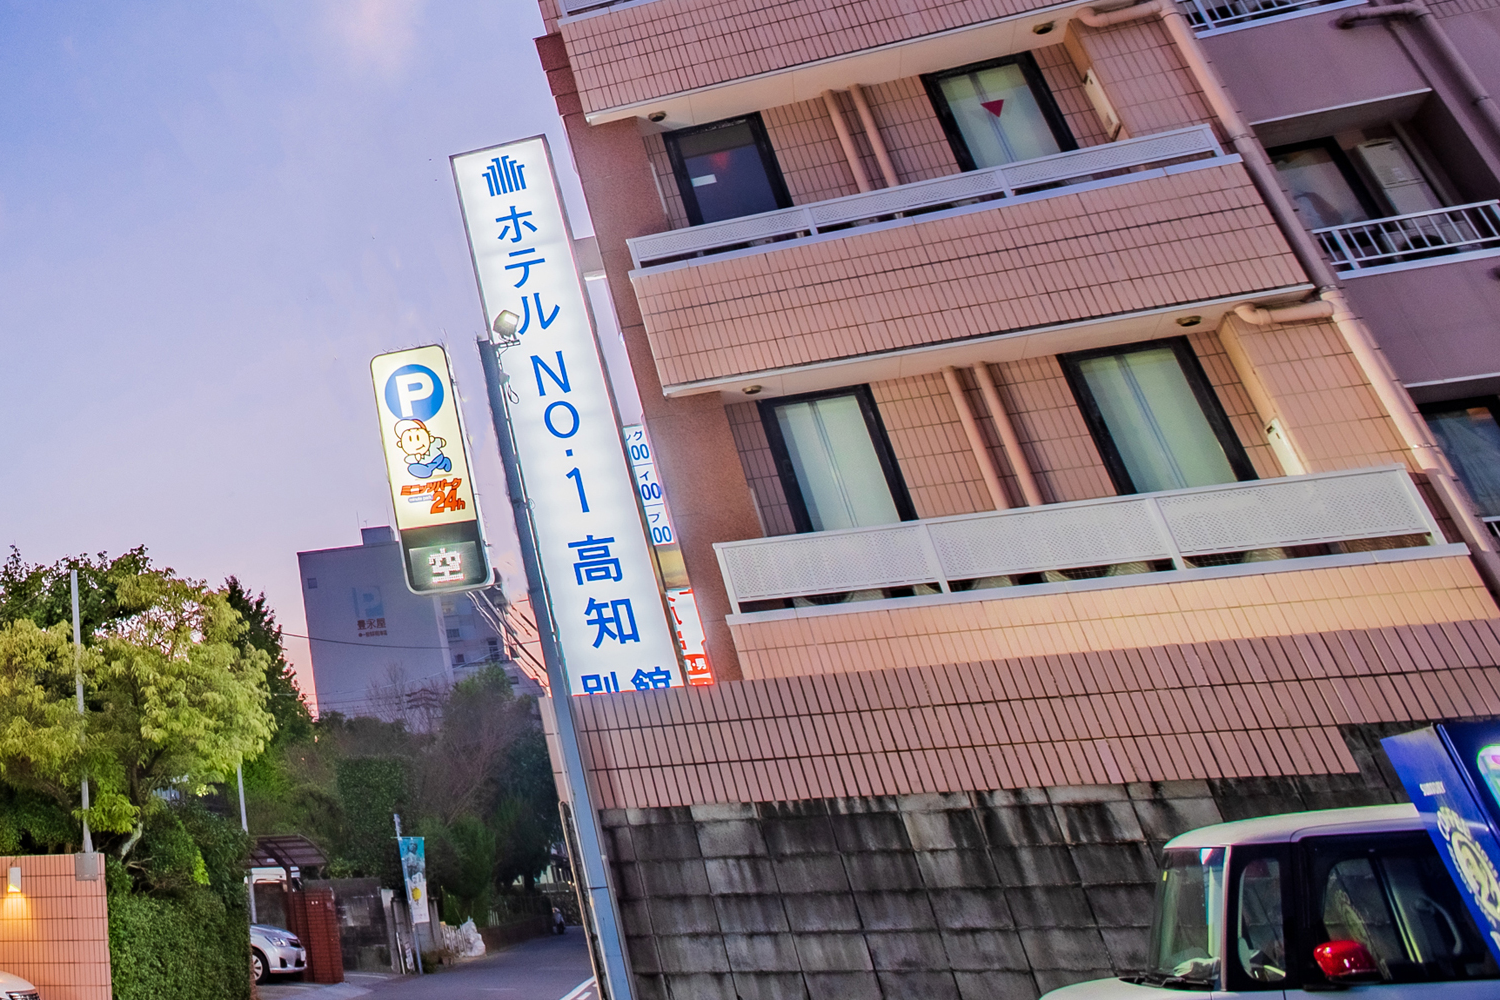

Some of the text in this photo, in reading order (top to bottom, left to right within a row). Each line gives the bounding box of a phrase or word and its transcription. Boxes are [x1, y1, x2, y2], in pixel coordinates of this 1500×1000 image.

[395, 371, 435, 418] P
[400, 478, 462, 496] ミニッツパーク
[430, 489, 466, 514] 24h
[428, 548, 465, 584] 空
